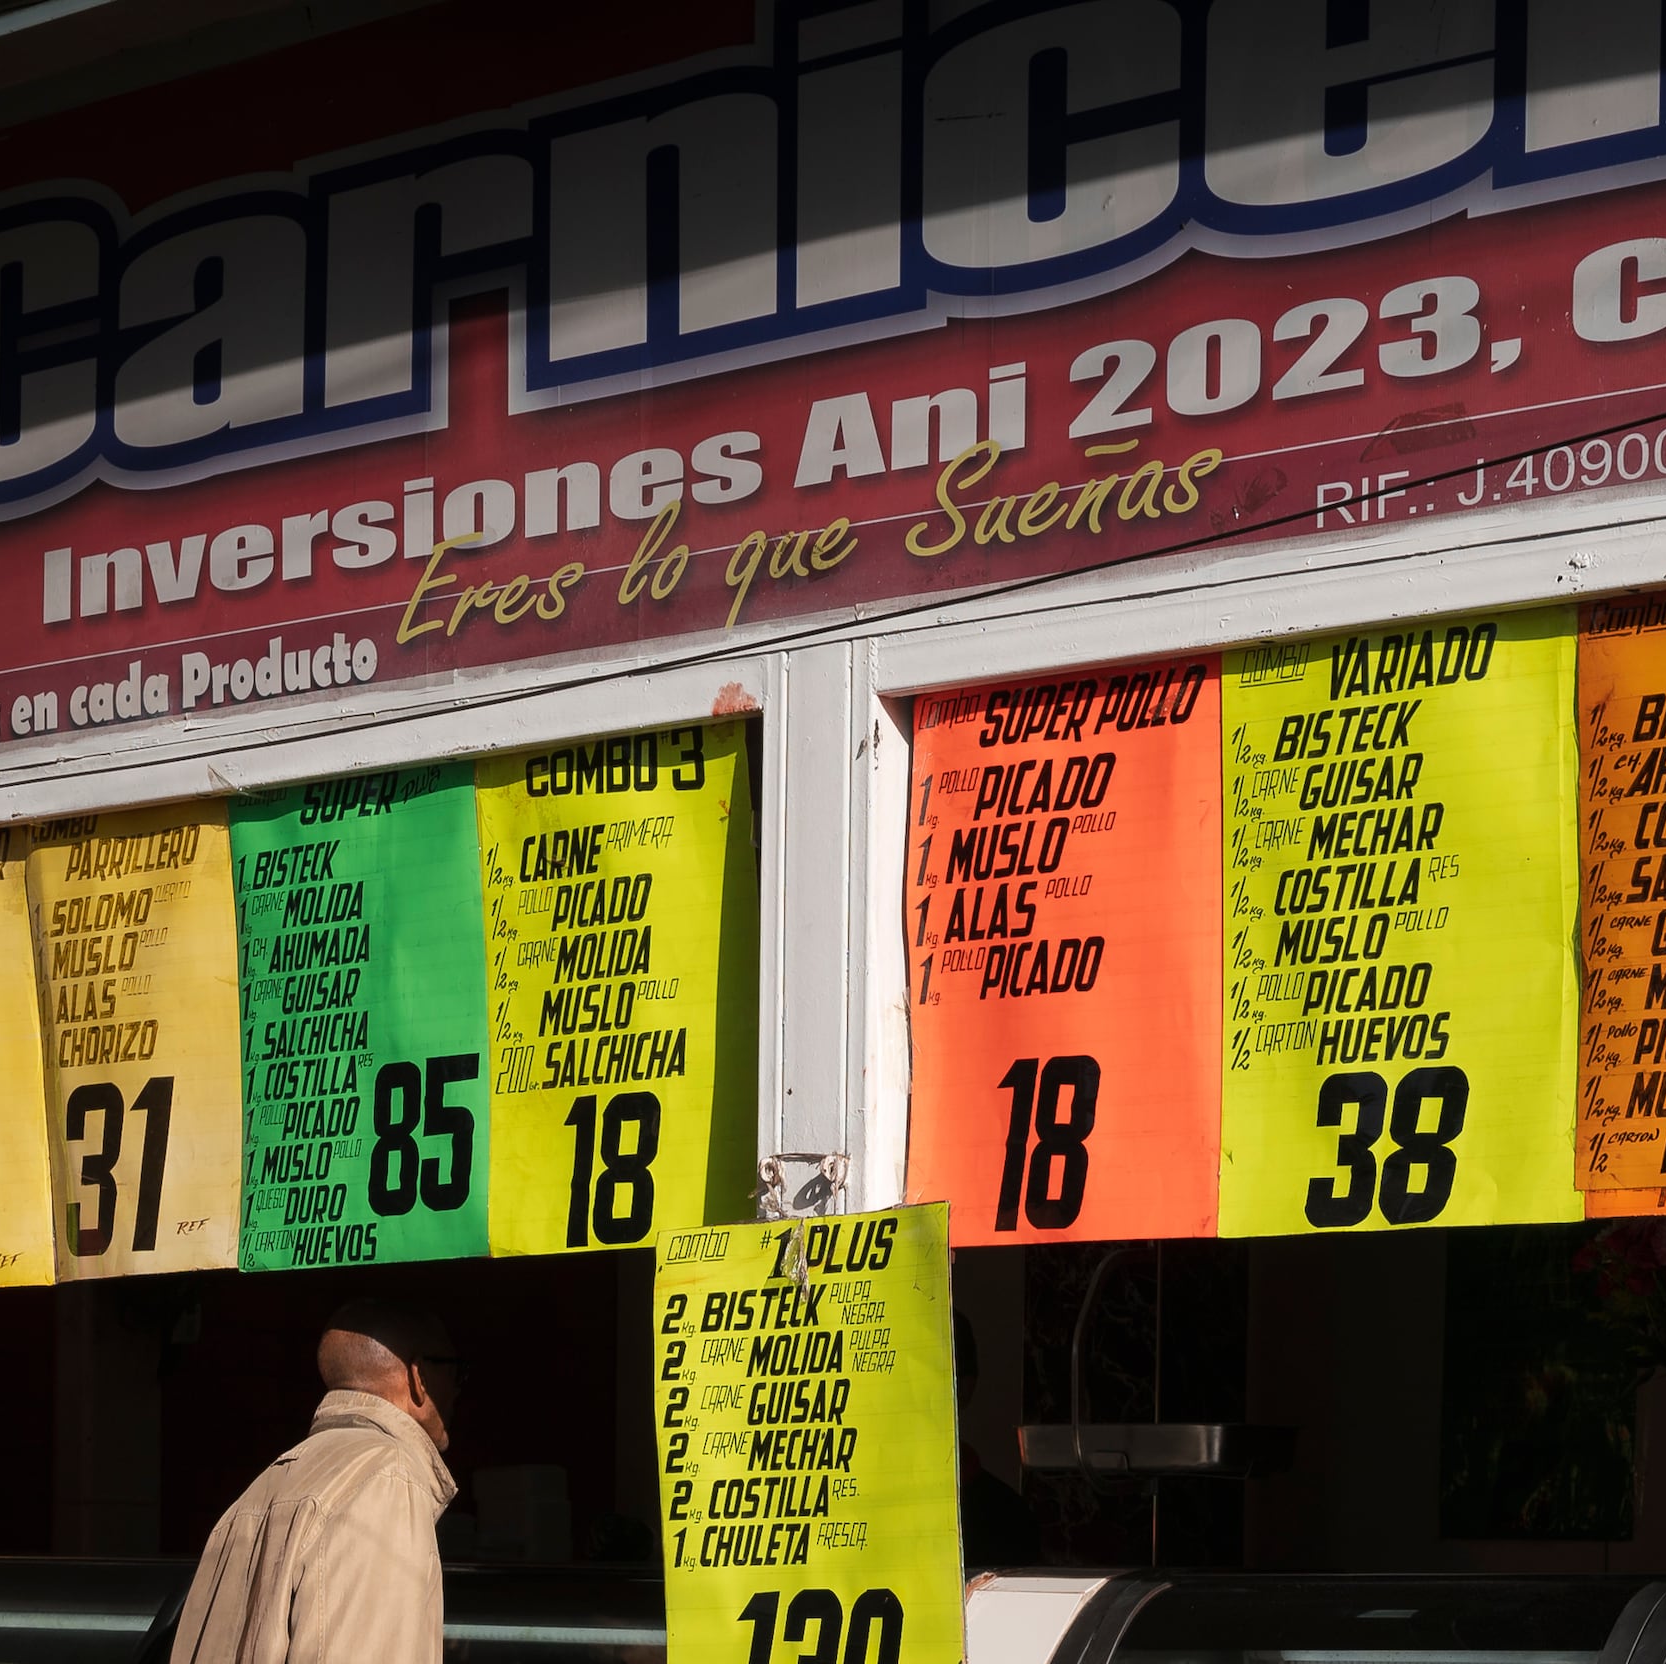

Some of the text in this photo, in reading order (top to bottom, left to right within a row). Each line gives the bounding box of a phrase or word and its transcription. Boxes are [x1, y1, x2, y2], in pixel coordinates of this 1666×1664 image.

[41, 426, 765, 626] Inversiones
[794, 361, 1028, 490] Ani
[1067, 274, 1523, 441] 2023,
[396, 440, 1223, 644] Eres lo que Sueñas
[11, 689, 58, 734] en
[70, 660, 169, 726] cada
[182, 632, 377, 709] Producto
[1329, 623, 1498, 703] VARIADO
[979, 663, 1206, 748] SUPER POLLO
[526, 737, 658, 798] COMBO
[973, 752, 1116, 822] PICADO
[1299, 753, 1423, 811] GUISAR
[65, 824, 200, 882] PARRILLERO
[607, 816, 675, 852] PRIMERA
[1072, 811, 1116, 835] POLLO
[1307, 802, 1444, 861] MECHAR
[51, 888, 152, 938] SOLOMO
[943, 882, 1038, 944] ALAS
[262, 1011, 369, 1059] SALCHICHA
[541, 1027, 687, 1090] SALCHICHA
[1317, 1012, 1451, 1065] HUEVOS
[264, 1054, 357, 1100] COSTILLA
[369, 1052, 480, 1216] 85
[995, 1054, 1102, 1232] 18
[1304, 1065, 1470, 1229] 38
[66, 1076, 174, 1256] 31
[565, 1091, 662, 1248] 18
[806, 1218, 898, 1273] PLUS
[708, 1476, 829, 1520] COSTILLA
[700, 1522, 811, 1567] CHULETA
